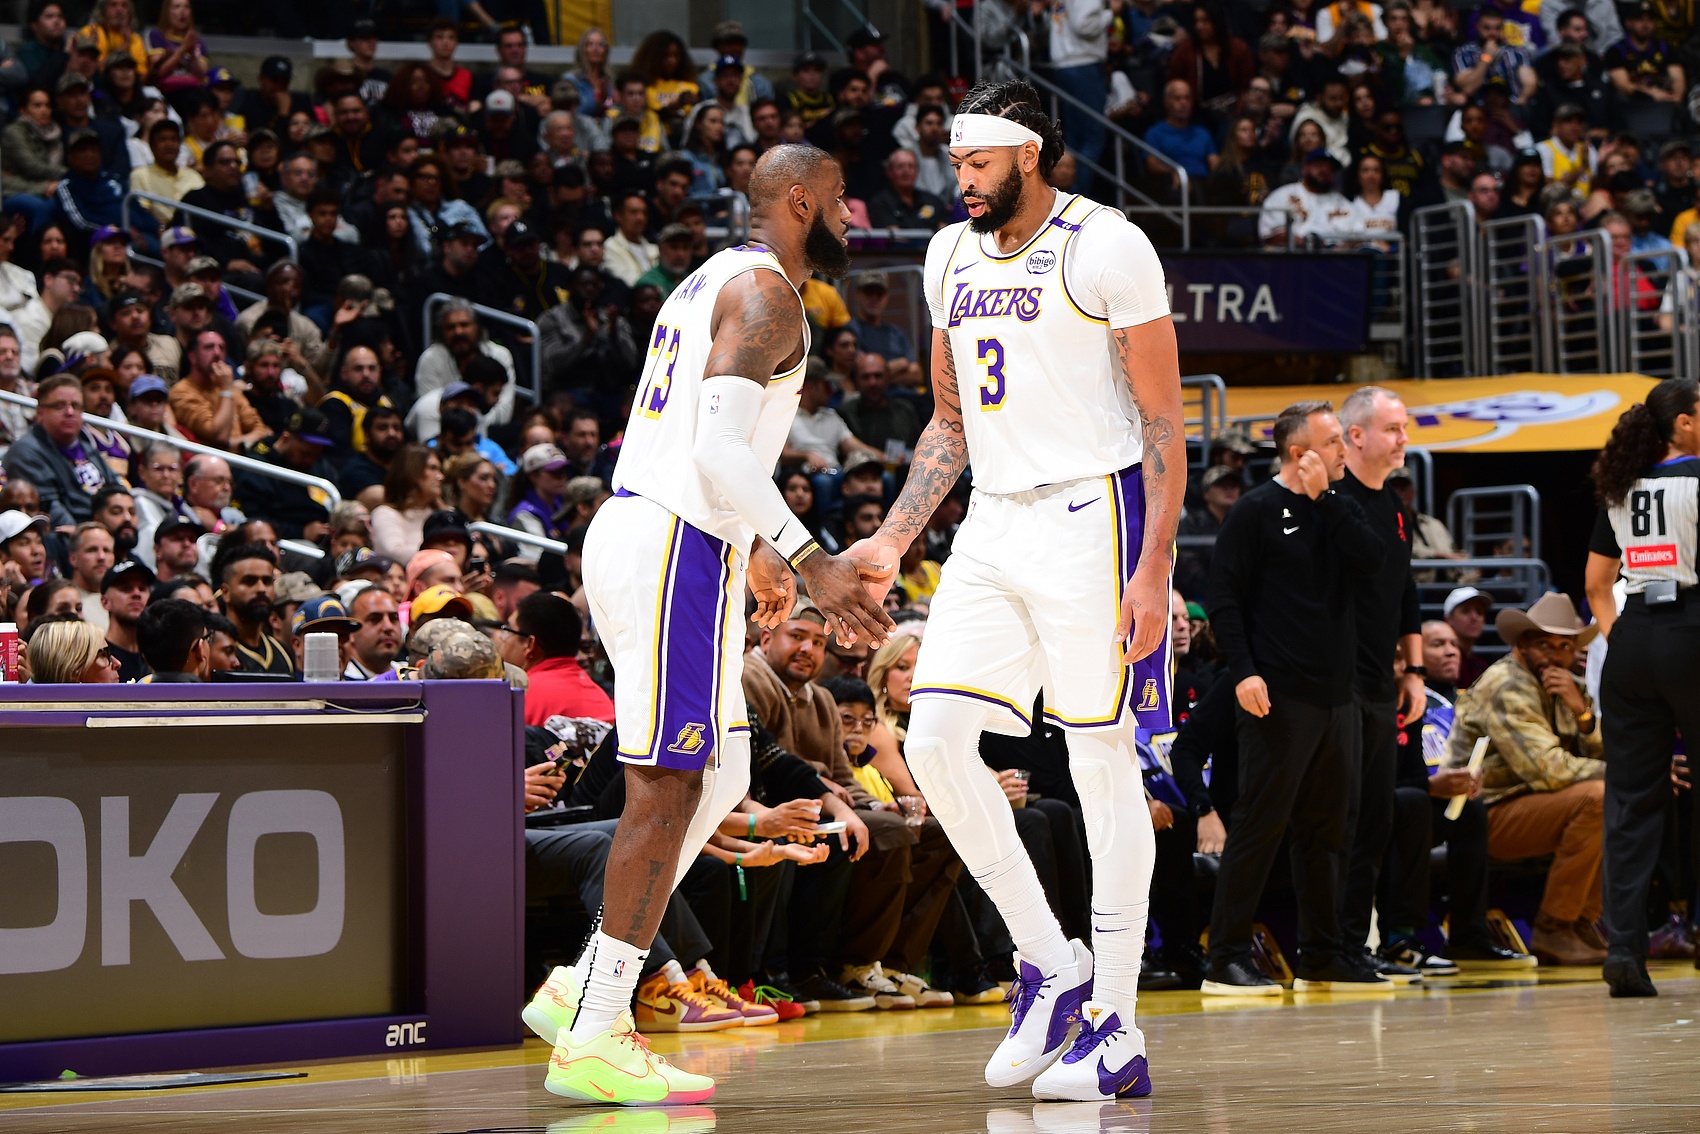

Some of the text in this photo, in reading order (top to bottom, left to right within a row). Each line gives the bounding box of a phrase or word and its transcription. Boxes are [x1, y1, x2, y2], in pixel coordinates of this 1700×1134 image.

[1029, 256, 1055, 268] bibigo
[947, 282, 1044, 330] LAKERS
[975, 336, 1008, 413] 3
[1631, 489, 1666, 537] 81
[1629, 550, 1674, 563] Emirates
[385, 1021, 427, 1047] anc
